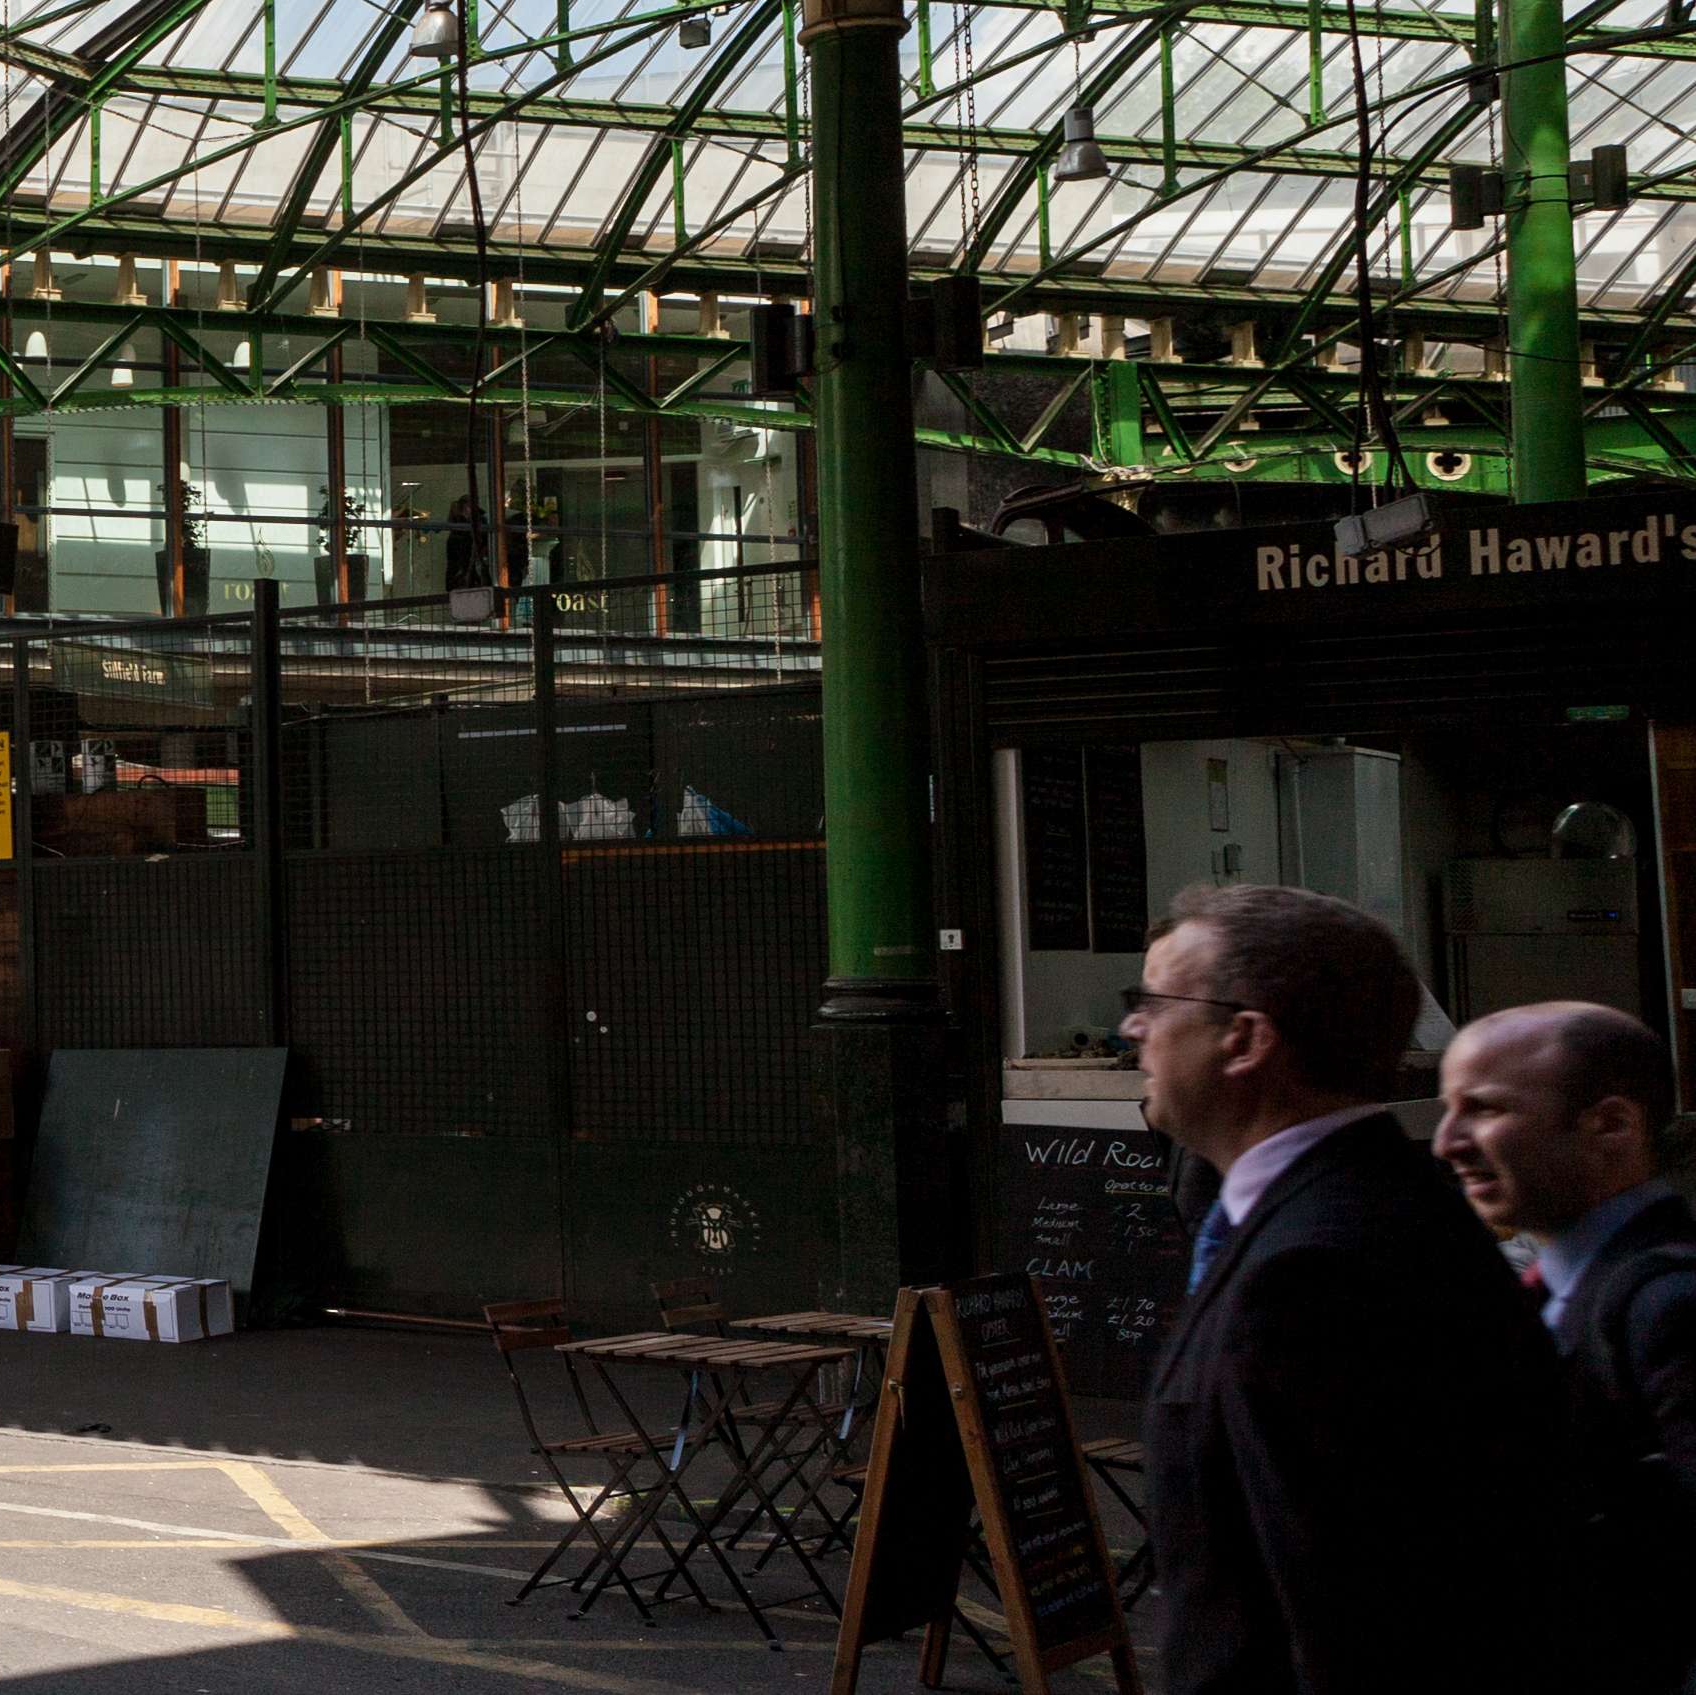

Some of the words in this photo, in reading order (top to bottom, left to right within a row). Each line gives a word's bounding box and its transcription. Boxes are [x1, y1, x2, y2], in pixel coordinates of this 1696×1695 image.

[1256, 533, 1443, 591] Richard
[1467, 511, 1696, 576] Haward's
[1025, 1138, 1096, 1164] Wild
[1025, 1257, 1095, 1280] CLAM
[76, 1291, 109, 1302] Moe
[109, 1293, 130, 1302] Box
[1044, 1295, 1081, 1310] arge
